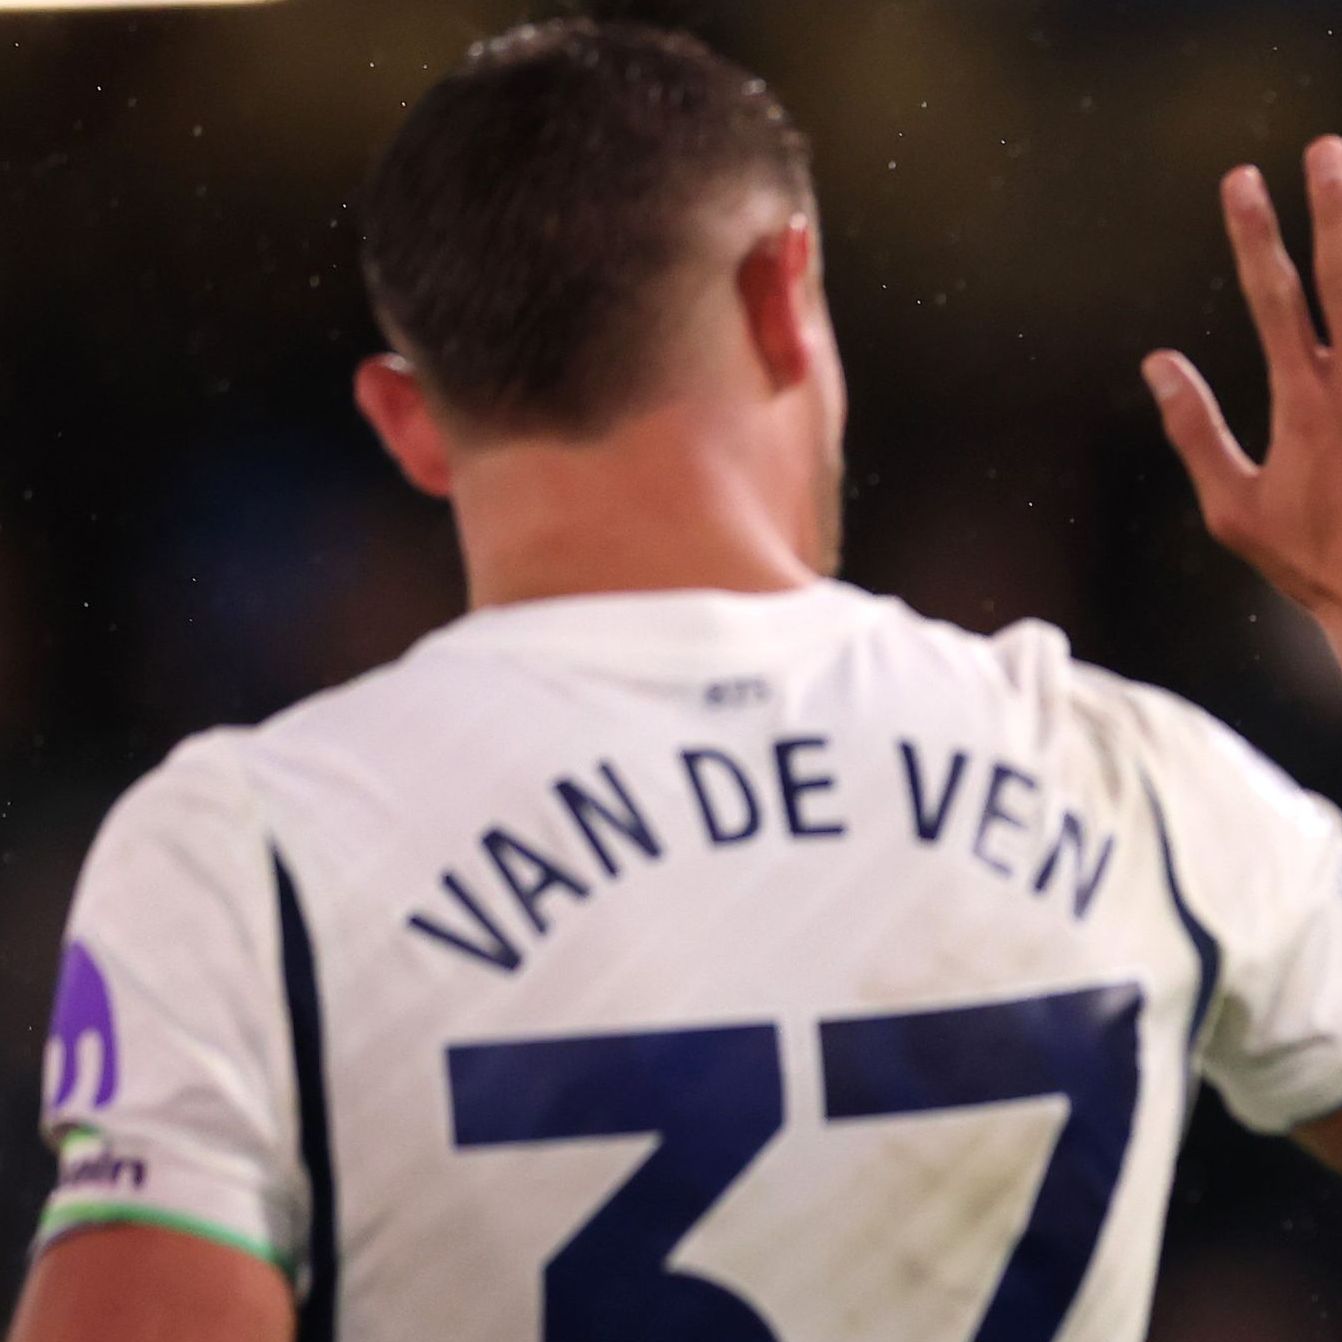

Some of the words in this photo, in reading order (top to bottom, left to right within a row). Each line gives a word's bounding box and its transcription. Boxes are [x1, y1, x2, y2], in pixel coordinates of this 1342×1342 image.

[407, 759, 664, 974] VAN
[680, 735, 846, 847] DE
[897, 740, 1117, 922] VEN
